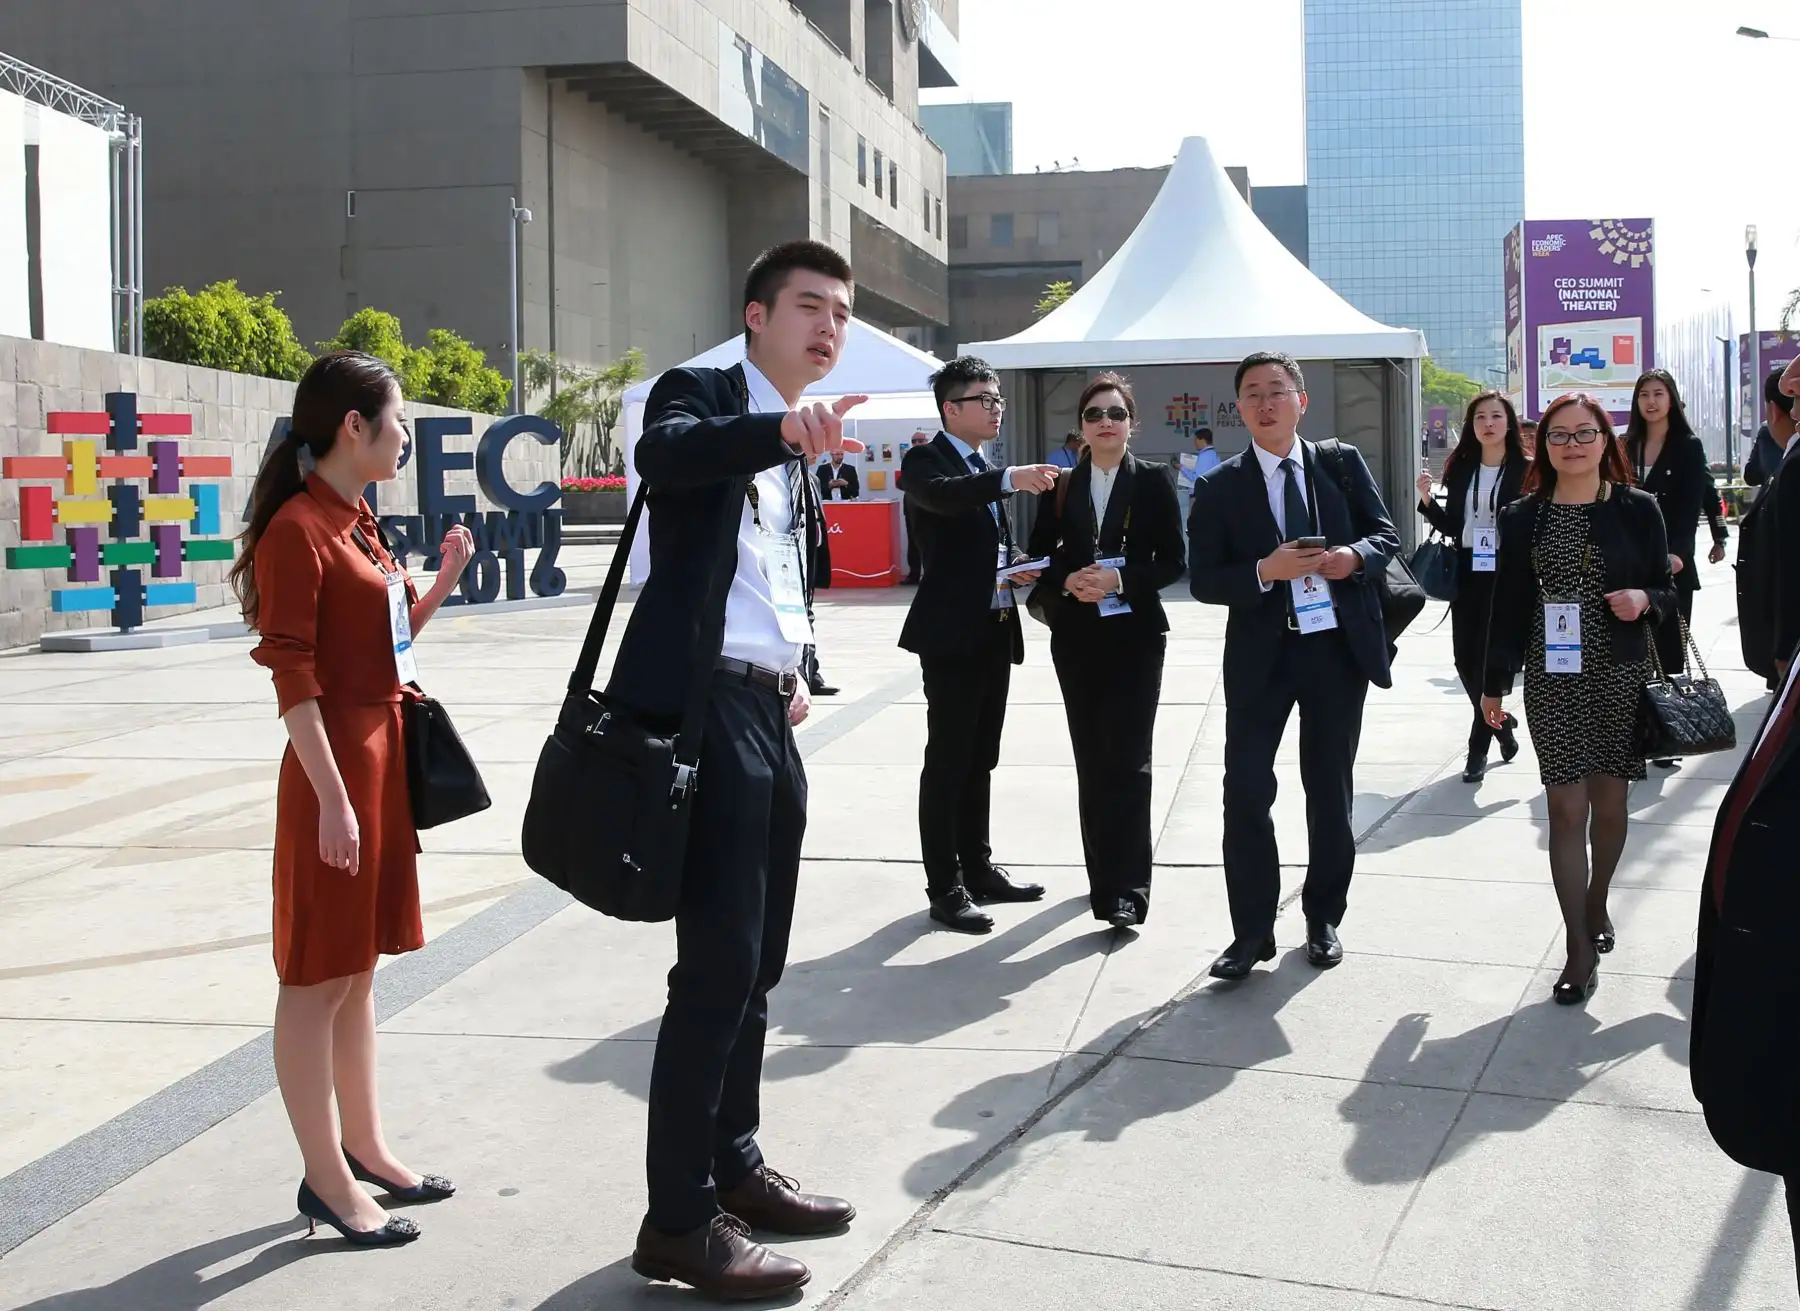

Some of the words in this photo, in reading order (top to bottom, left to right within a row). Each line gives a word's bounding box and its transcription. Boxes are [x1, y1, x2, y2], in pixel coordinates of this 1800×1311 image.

[1546, 233, 1564, 241] APEC
[1554, 278, 1577, 288] CEO
[1578, 277, 1625, 288] SUMMIT
[1558, 288, 1621, 301] (NATIONAL
[1561, 299, 1617, 312] THEATER)
[1216, 402, 1237, 414] AP
